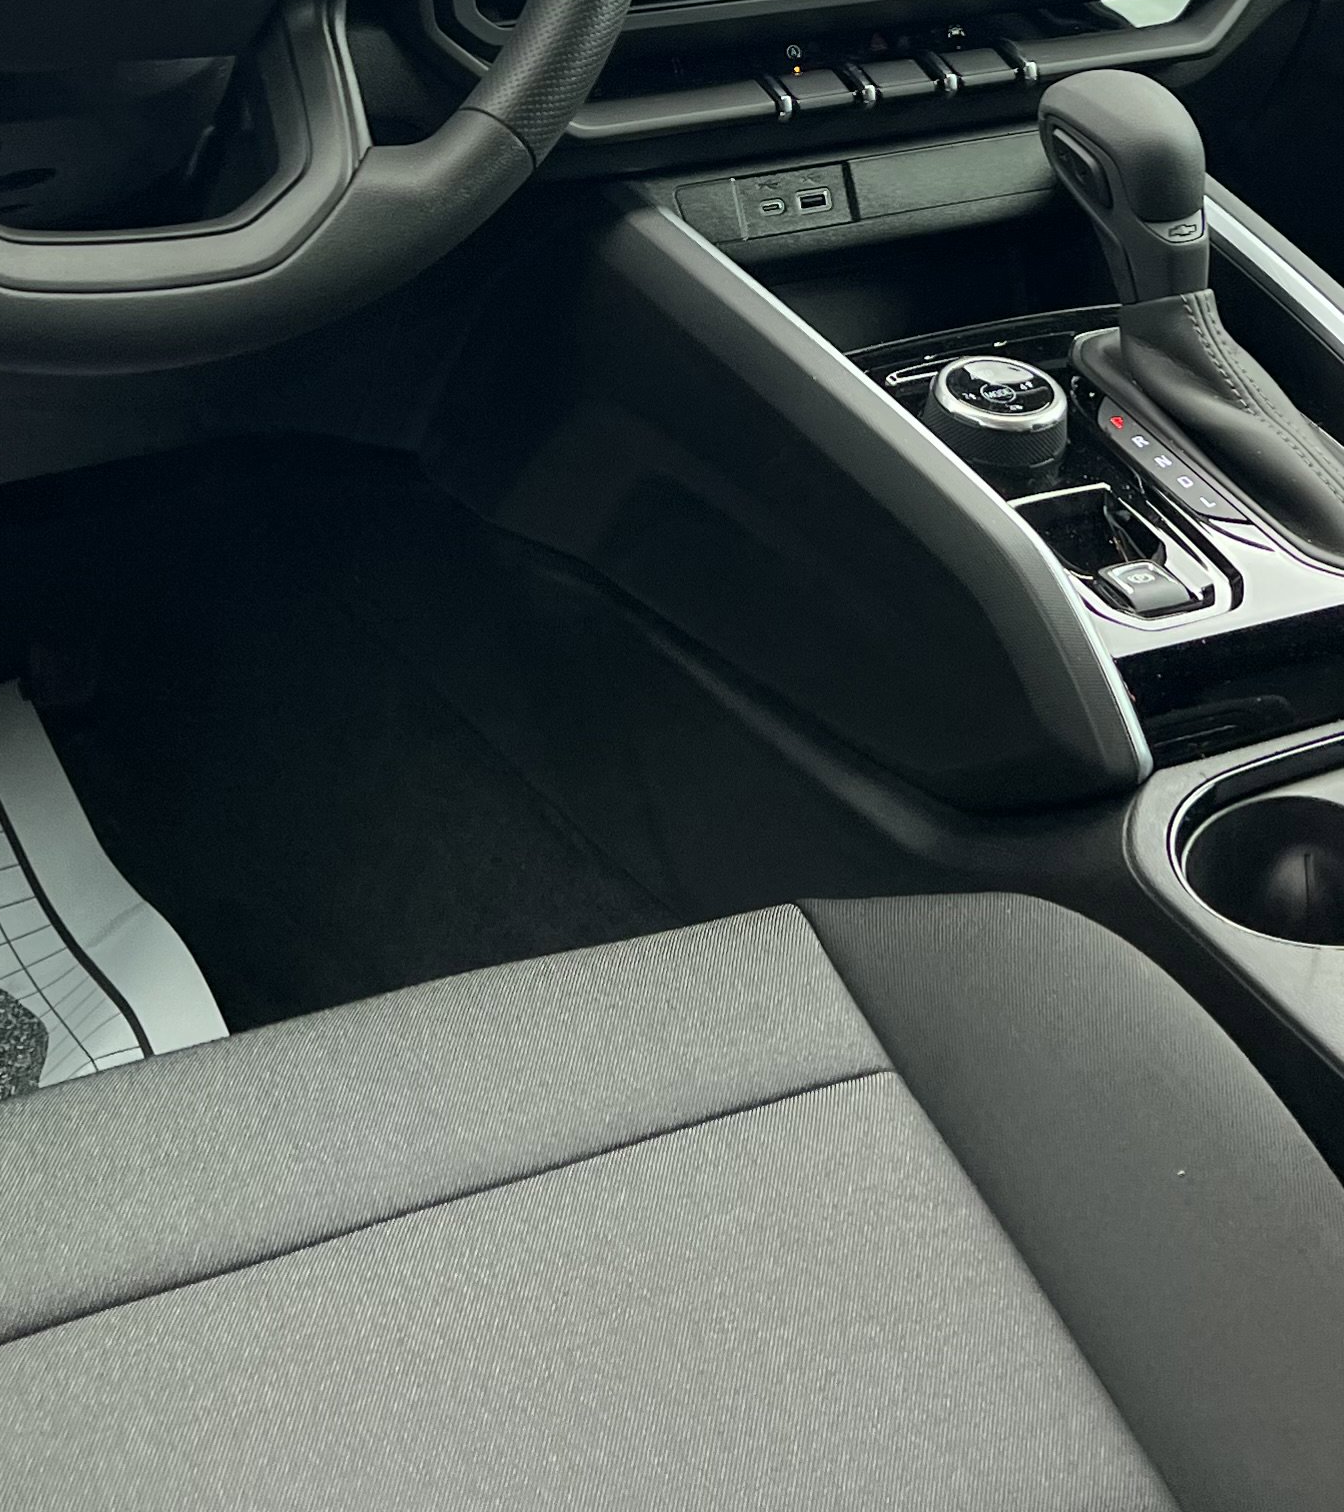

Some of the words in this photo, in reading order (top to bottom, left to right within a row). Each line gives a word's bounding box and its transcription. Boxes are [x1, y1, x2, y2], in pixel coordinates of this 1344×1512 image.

[1131, 435, 1150, 448] R
[1154, 454, 1172, 469] N
[1177, 476, 1194, 489] D
[1199, 496, 1216, 508] L
